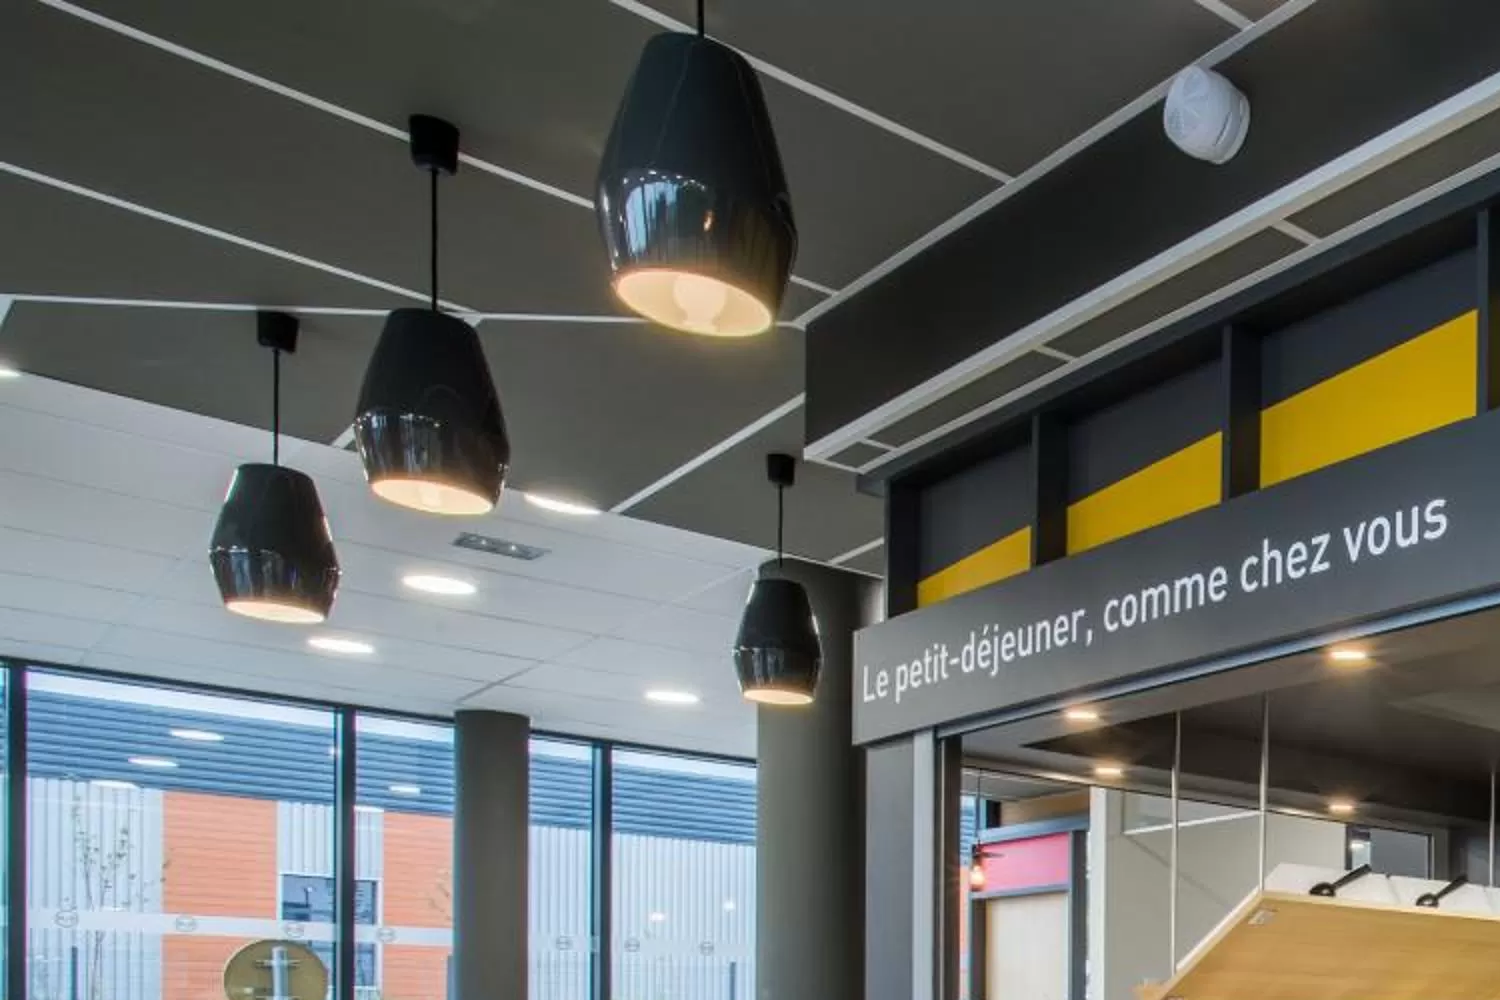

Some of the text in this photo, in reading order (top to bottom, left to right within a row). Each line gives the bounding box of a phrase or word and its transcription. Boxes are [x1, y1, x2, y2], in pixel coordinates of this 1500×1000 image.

[862, 497, 1449, 703] Le petit-déjeuner, comme chez vous
